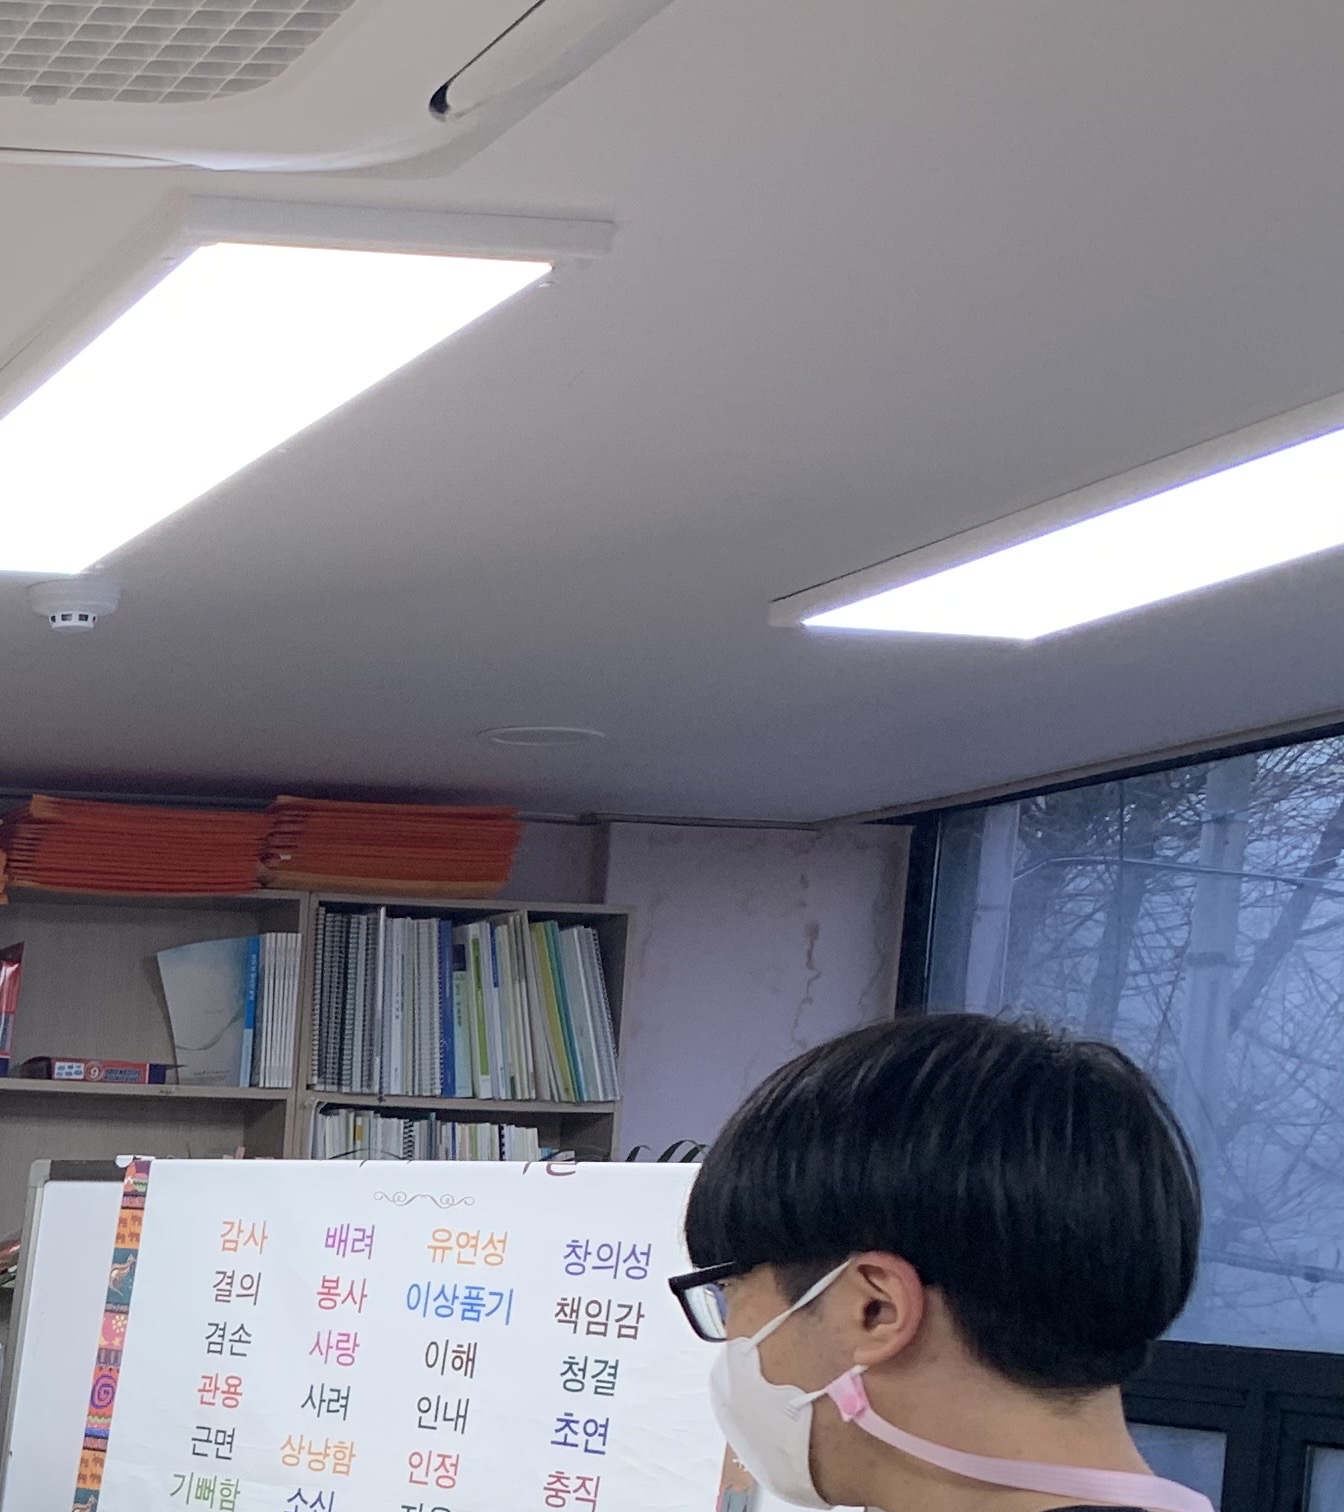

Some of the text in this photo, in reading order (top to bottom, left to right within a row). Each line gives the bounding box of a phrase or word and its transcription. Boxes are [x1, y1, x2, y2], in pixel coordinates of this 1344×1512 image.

[220, 1220, 268, 1255] 감사
[324, 1223, 376, 1260] 배려
[427, 1228, 508, 1267] 유연성
[563, 1238, 652, 1281] 창의성
[212, 1269, 262, 1307] 결의
[316, 1274, 368, 1314] 봉사
[406, 1281, 514, 1326] 이상품기
[554, 1295, 646, 1341] 책임감
[204, 1321, 253, 1358] 겸손
[308, 1329, 361, 1367] 사랑
[424, 1338, 478, 1380] 이해
[197, 1372, 243, 1409] 관용
[559, 1355, 620, 1397] 청결
[300, 1382, 352, 1422] 사려
[416, 1394, 470, 1435] 인내
[190, 1425, 236, 1461] 근면
[550, 1411, 610, 1456] 초연
[280, 1434, 356, 1476] 상냥함
[408, 1450, 460, 1490] 인정
[169, 1471, 241, 1512] 기뻐함
